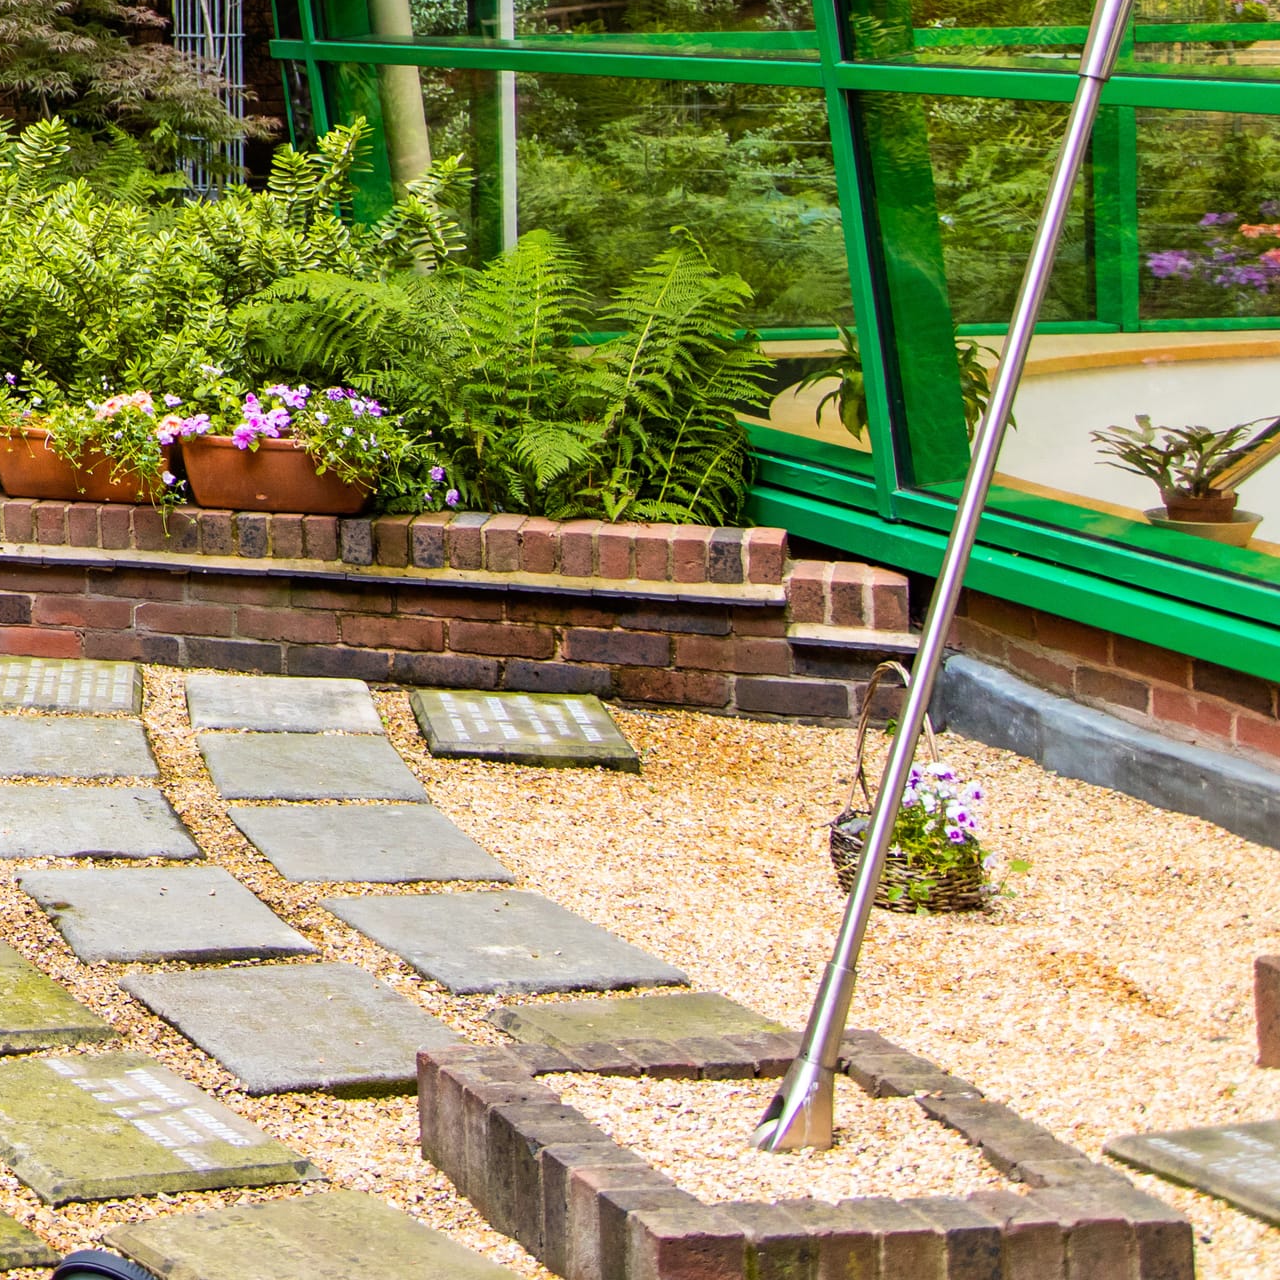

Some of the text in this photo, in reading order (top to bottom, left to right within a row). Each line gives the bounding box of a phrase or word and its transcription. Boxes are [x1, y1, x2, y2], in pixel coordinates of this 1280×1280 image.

[42, 1058, 79, 1076] DIED
[88, 1092, 117, 1102] OF
[126, 1118, 182, 1147] MONTH
[100, 1077, 142, 1097] AGED
[120, 1068, 192, 1105] THOMAS
